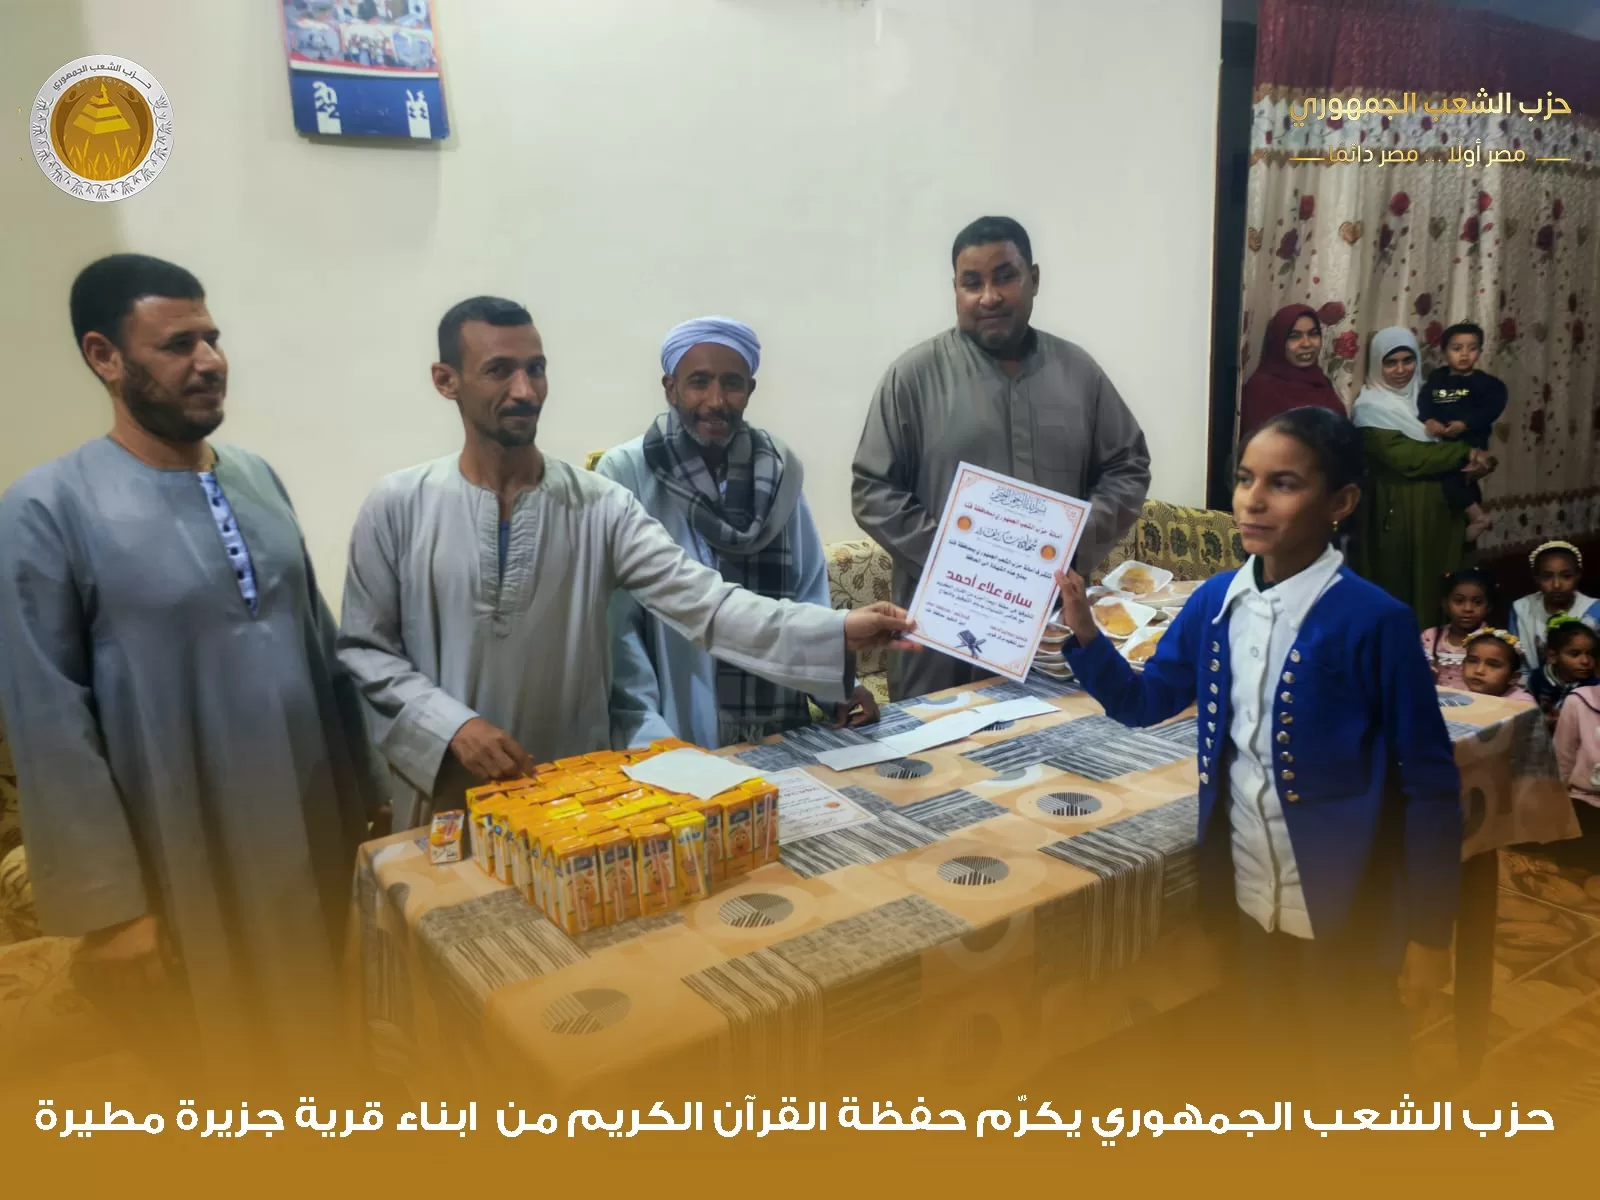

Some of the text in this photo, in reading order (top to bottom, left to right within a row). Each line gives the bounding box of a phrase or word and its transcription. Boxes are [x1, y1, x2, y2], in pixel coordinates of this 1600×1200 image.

[946, 570, 977, 587] أحمد
[976, 581, 1002, 597] علاء
[1003, 591, 1032, 608] سارة
